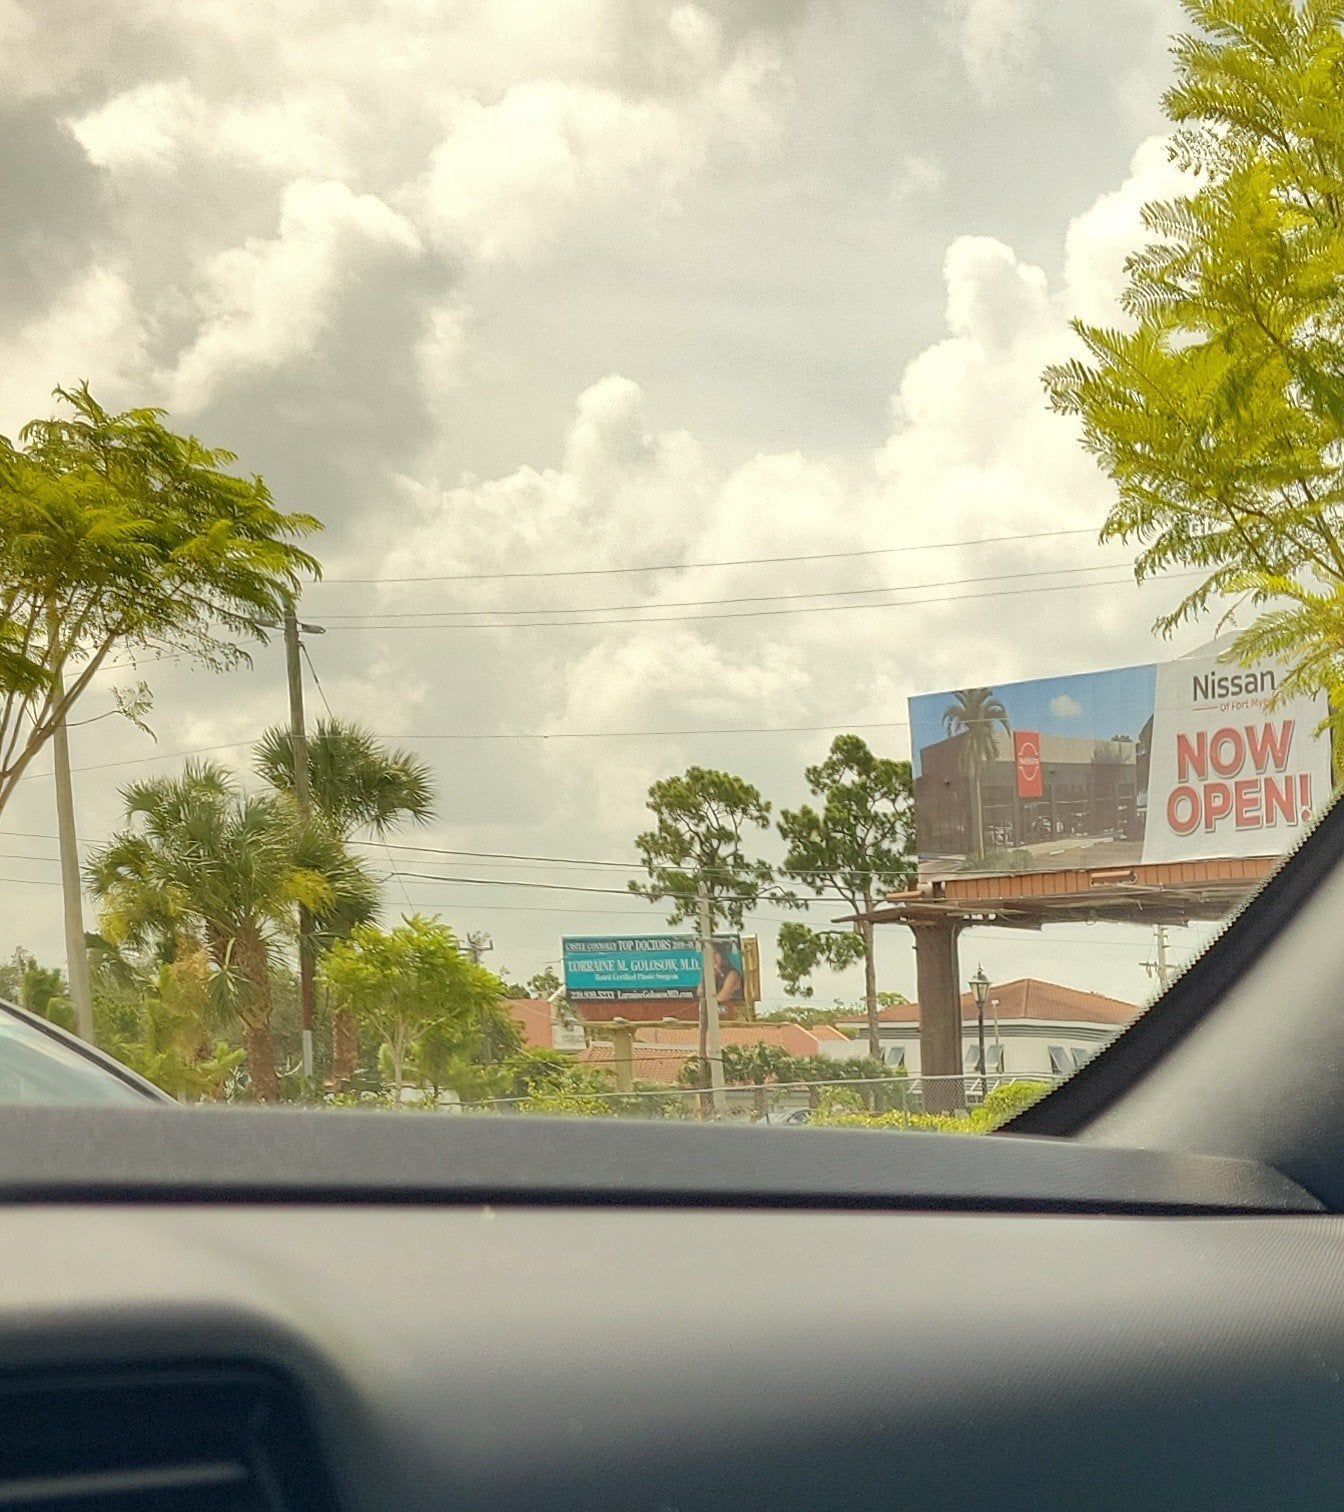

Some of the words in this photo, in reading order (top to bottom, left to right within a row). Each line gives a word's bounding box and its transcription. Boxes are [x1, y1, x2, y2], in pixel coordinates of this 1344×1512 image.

[1193, 670, 1275, 701] Nissan
[1176, 719, 1295, 783] NOW
[1165, 771, 1313, 836] OPEN!
[618, 940, 634, 951] TOP
[636, 939, 672, 951] DOCTORS
[569, 960, 615, 972] LORRAINE
[617, 960, 629, 971] M.
[631, 959, 679, 972] GOLOSOW,
[680, 958, 701, 971] M.D.
